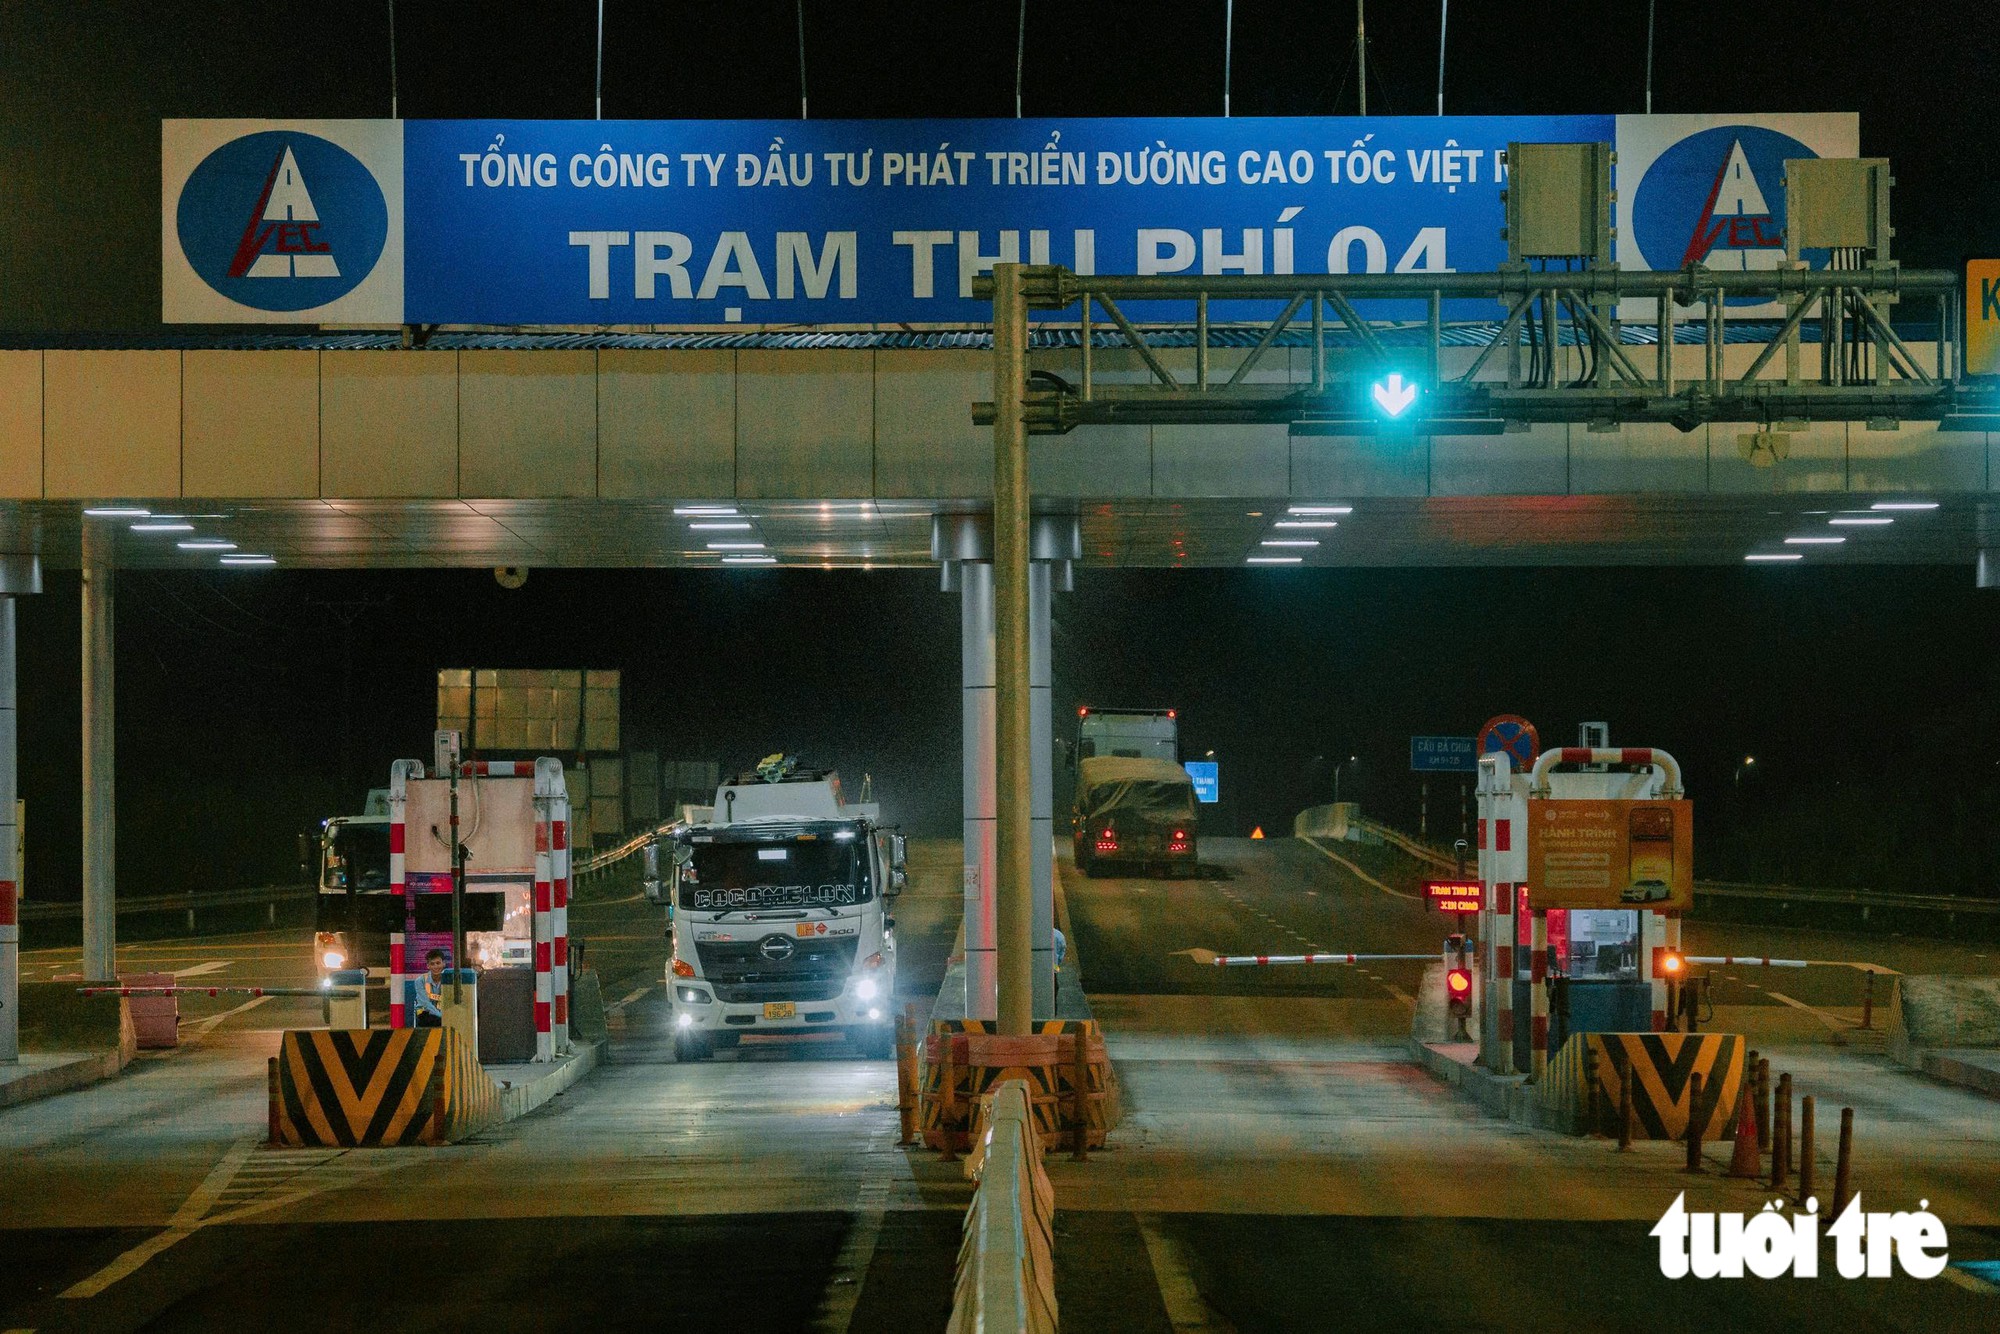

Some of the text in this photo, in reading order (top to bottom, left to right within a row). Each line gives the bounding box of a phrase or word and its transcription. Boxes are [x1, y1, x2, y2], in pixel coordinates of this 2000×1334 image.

[460, 134, 558, 188] TỔNG
[570, 144, 671, 188] CÔNG
[681, 154, 726, 187] TY
[736, 138, 813, 187] ĐẦU
[824, 149, 873, 187] TƯ
[884, 143, 976, 187] PHÁT
[986, 131, 1086, 186] TRIỂN
[1096, 141, 1227, 185] ĐƯỜNG
[1238, 150, 1315, 185] CAO
[1325, 134, 1397, 185] TỐC
[1407, 140, 1485, 193] VIỆT
[569, 231, 858, 323] TRẠM
[1137, 206, 1305, 276] PHÍ
[1327, 226, 1458, 276] 04
[694, 884, 856, 908] COCOMELON
